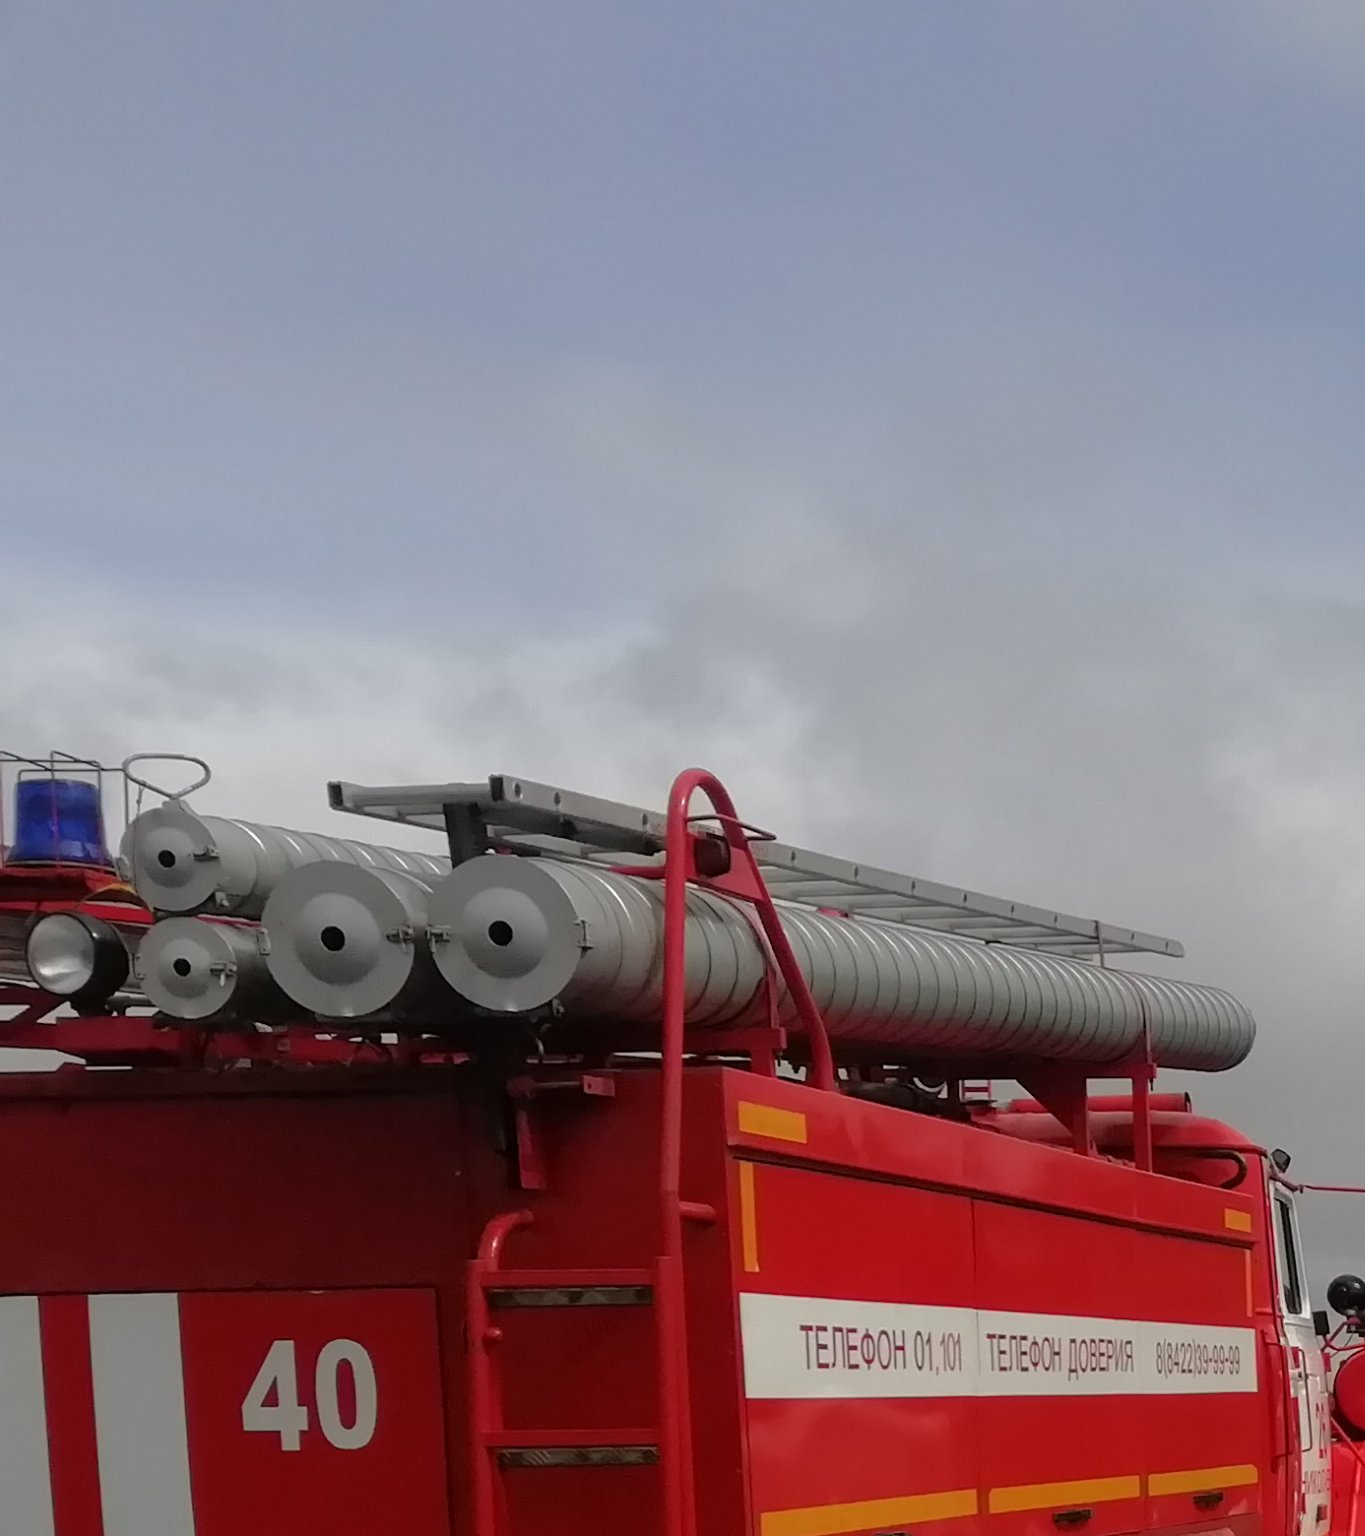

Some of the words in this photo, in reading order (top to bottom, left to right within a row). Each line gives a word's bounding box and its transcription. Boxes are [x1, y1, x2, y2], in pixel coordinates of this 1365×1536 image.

[800, 1324, 907, 1370] ТЕЛЕФОН
[986, 1333, 1062, 1373] ТЕЛЕФОН
[1068, 1337, 1134, 1381] ДОВЕРИЯ
[241, 1339, 378, 1451] 40
